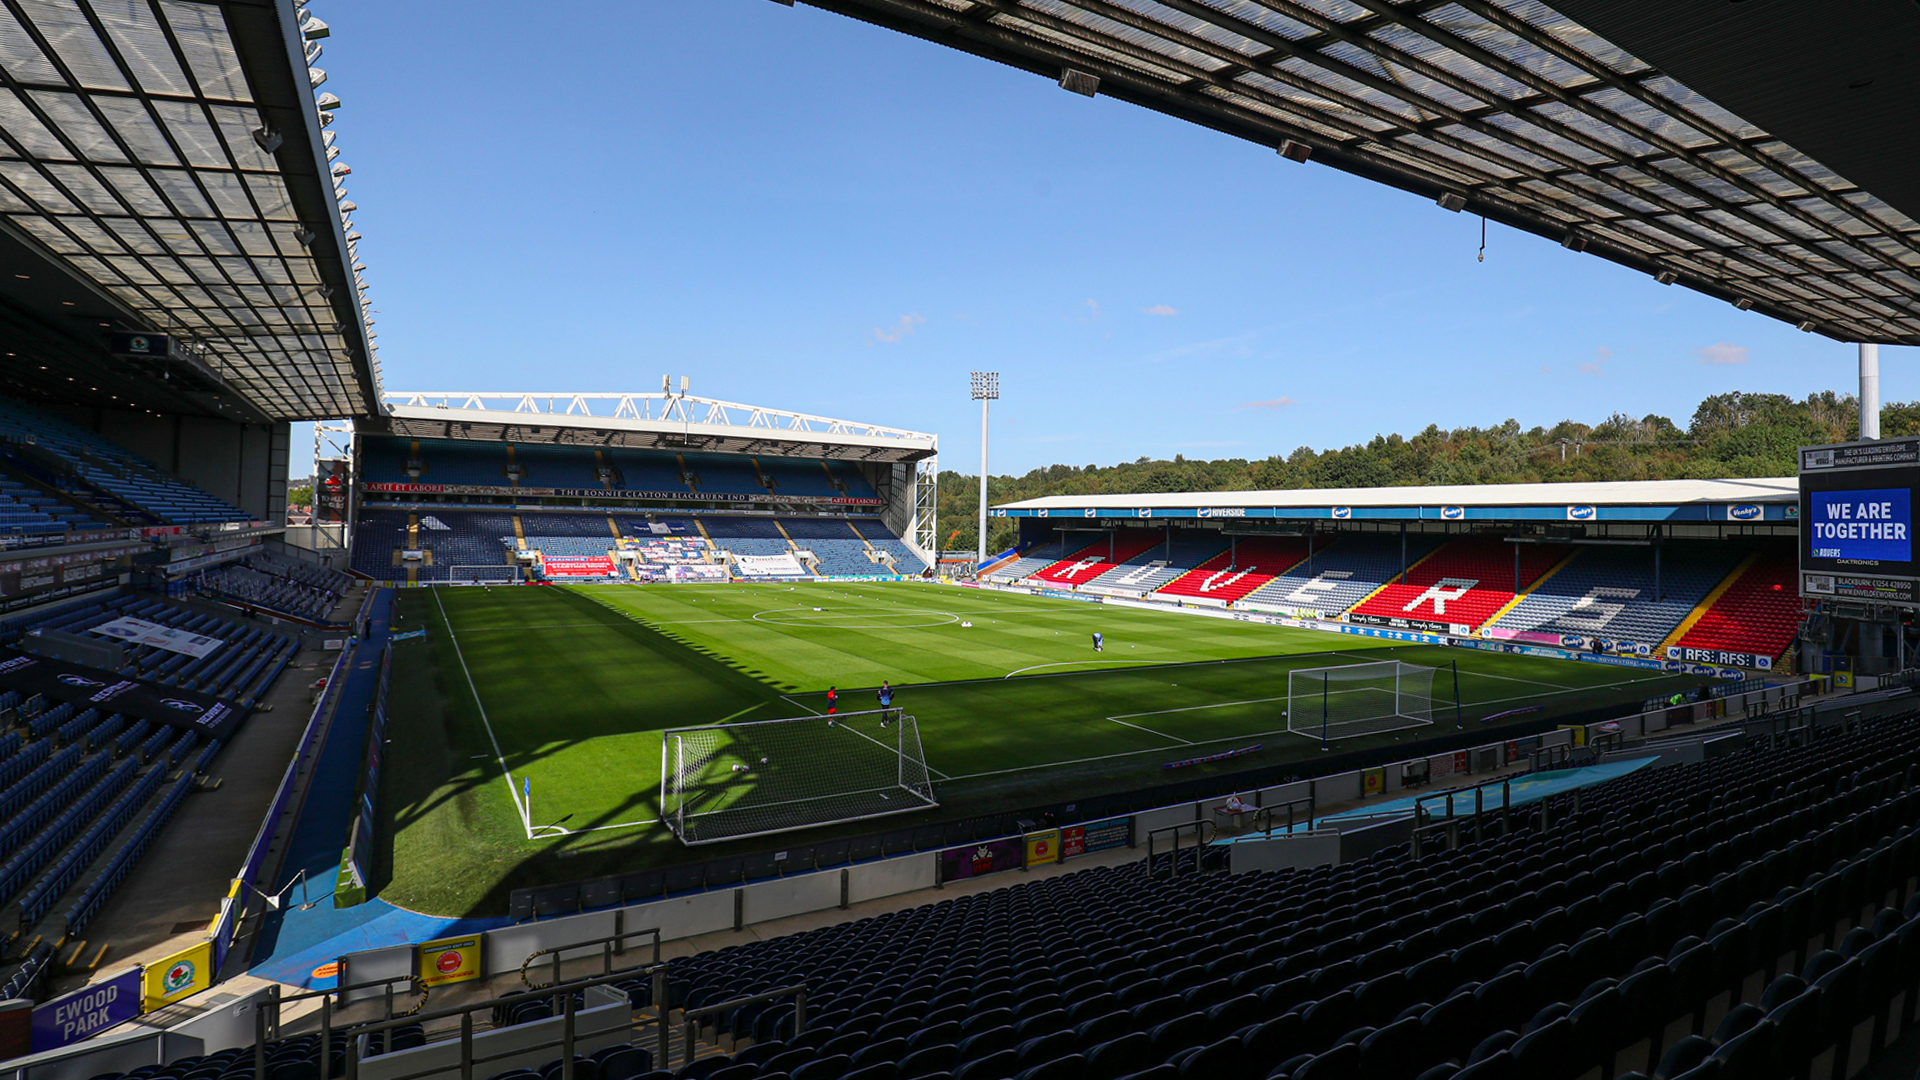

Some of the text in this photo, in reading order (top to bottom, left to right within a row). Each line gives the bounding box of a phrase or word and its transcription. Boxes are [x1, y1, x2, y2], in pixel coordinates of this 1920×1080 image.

[1883, 444, 1906, 453] ENVELOPE
[1835, 456, 1868, 465] MANUFACTURER
[1872, 454, 1893, 462] PRINTING
[1894, 452, 1917, 461] COMPANY
[370, 483, 393, 491] ARTE
[408, 484, 444, 492] LABORE
[626, 491, 668, 499] CLAYTON
[672, 492, 724, 500] BLACKBURN
[1212, 508, 1246, 517] RIVERSIDE
[1827, 502, 1892, 519] WE ARE
[1814, 523, 1906, 540] TOGETHER
[1820, 548, 1841, 557] ROVERS
[55, 985, 117, 1026] EWOOD
[64, 1006, 110, 1041] PARK
